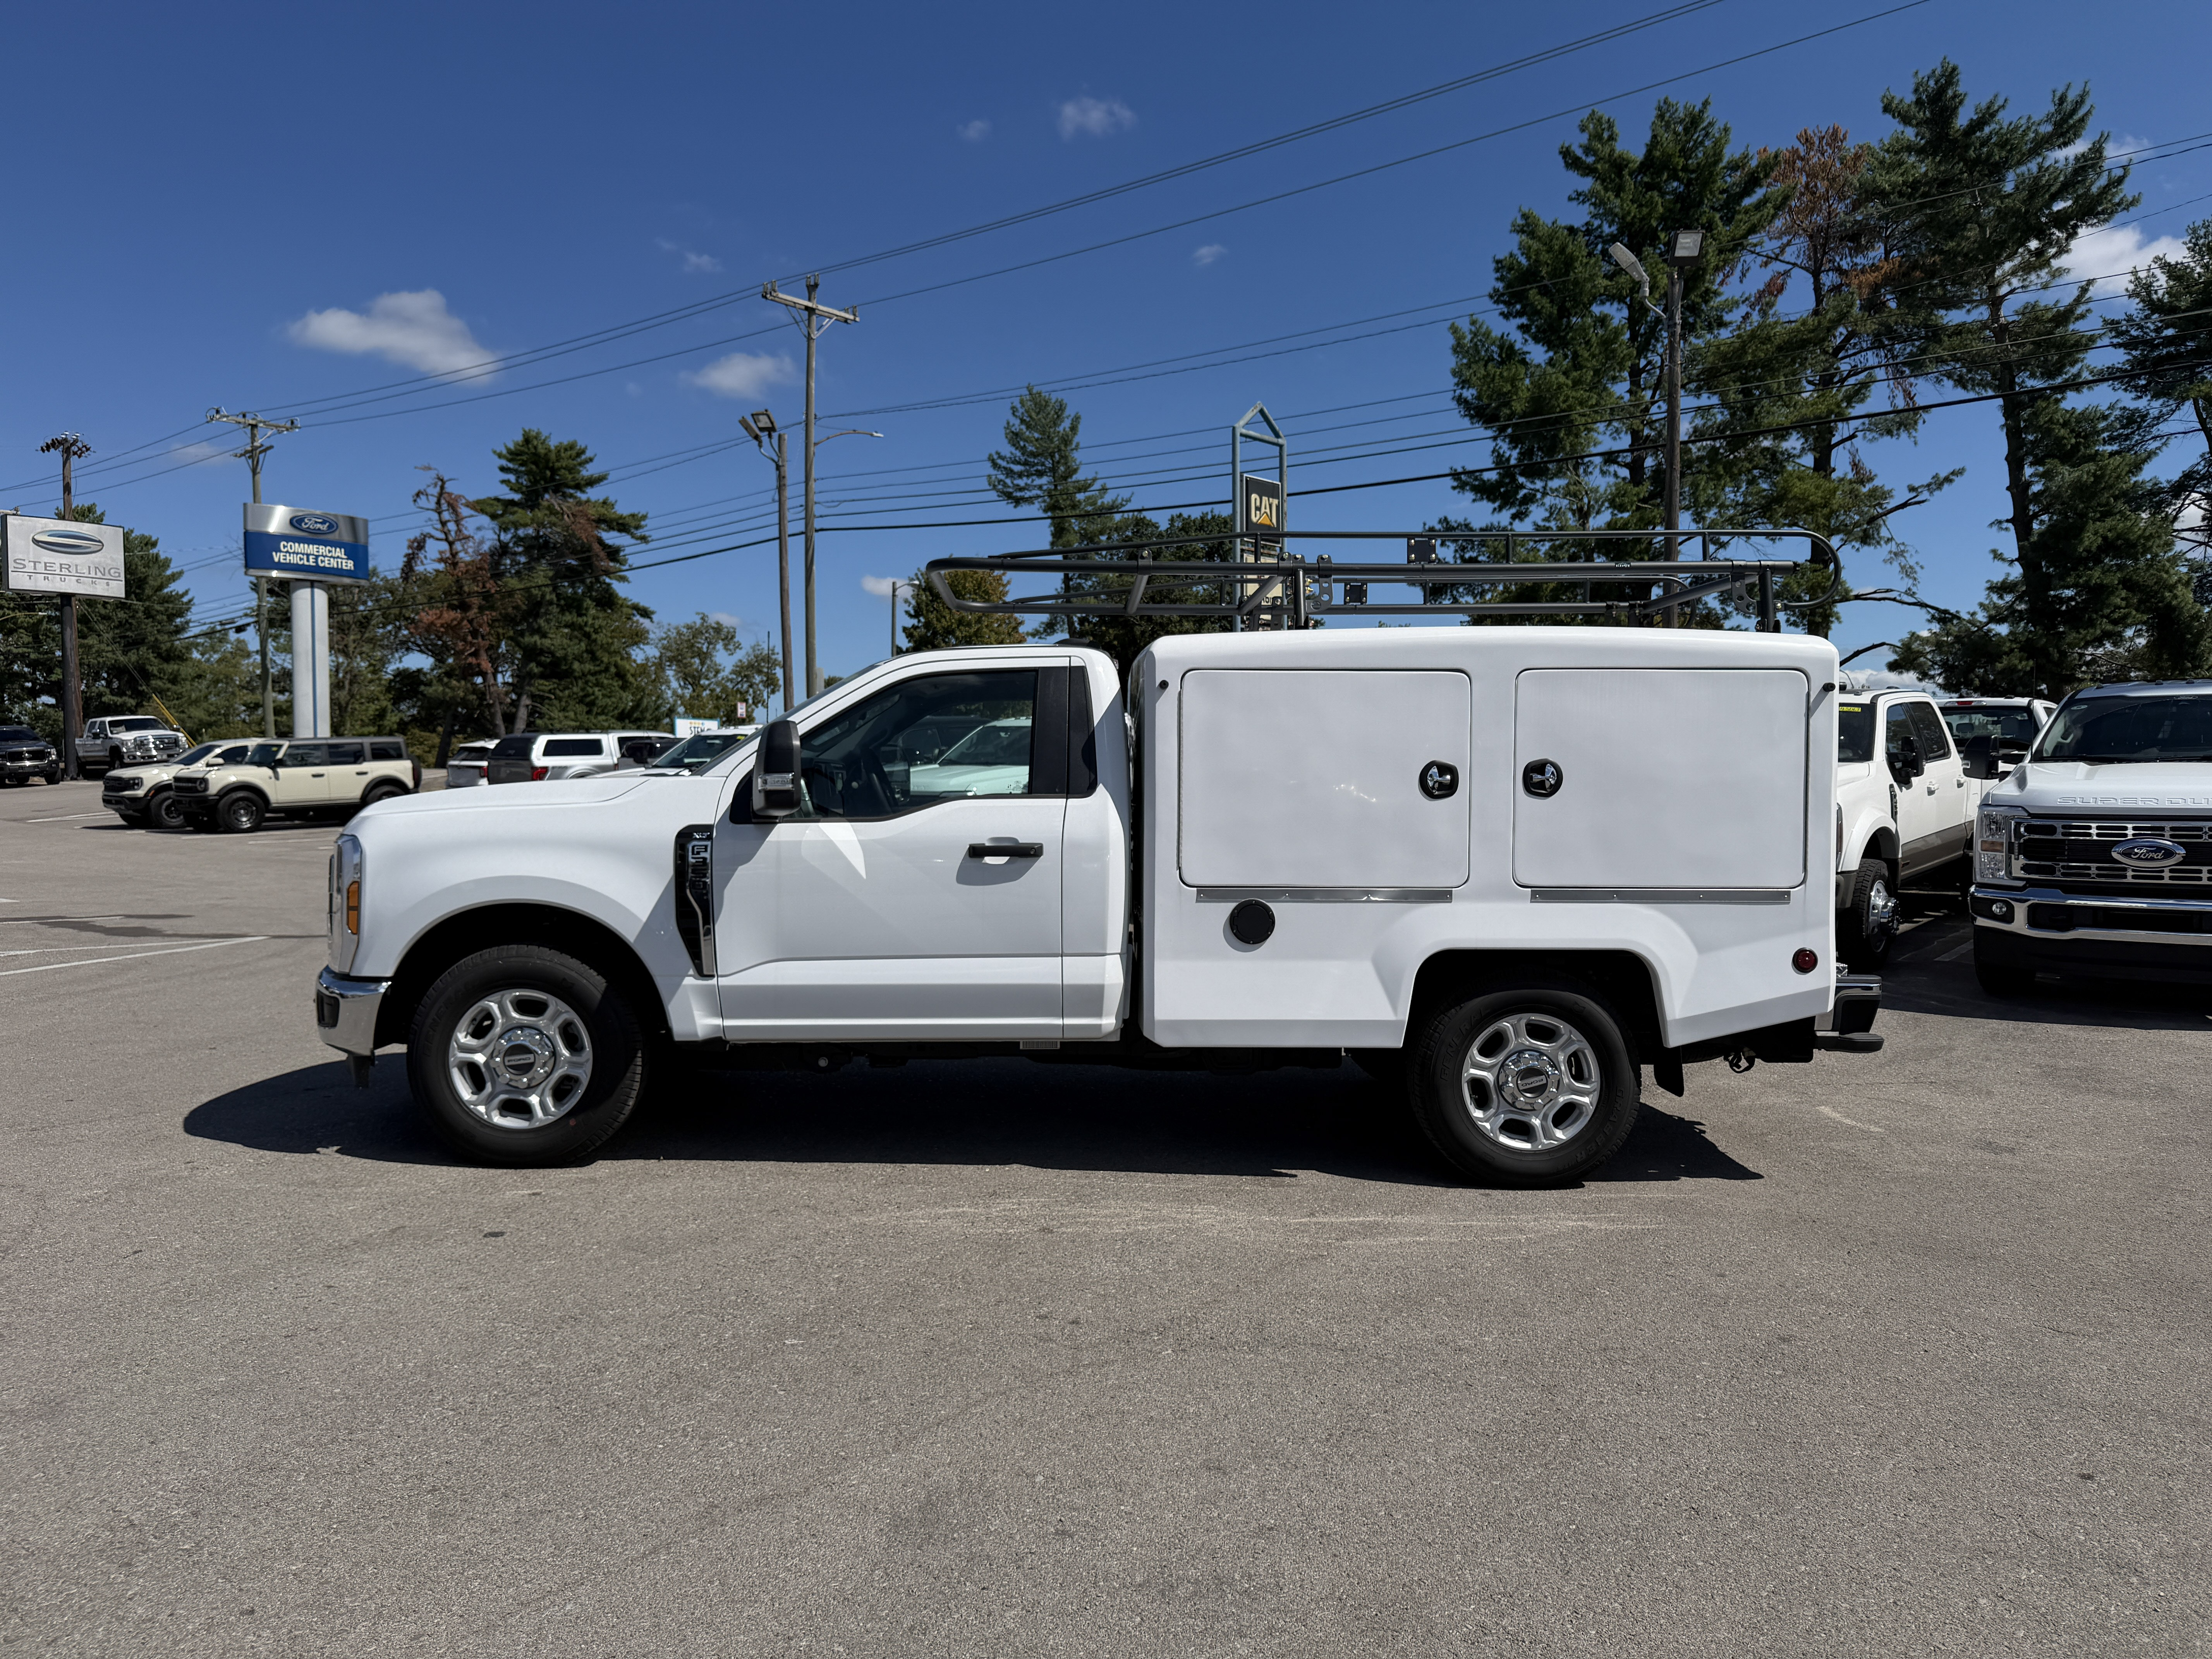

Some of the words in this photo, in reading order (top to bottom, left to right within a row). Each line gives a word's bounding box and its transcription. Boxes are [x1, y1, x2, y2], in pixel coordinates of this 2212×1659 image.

[1251, 494, 1279, 527] CAT
[302, 517, 329, 531] Ford
[280, 541, 348, 558] COMMERCIAL
[272, 551, 316, 566] VEHICLE
[318, 556, 354, 570] CENTER
[13, 558, 121, 578] STERLING
[27, 574, 110, 586] TRUCKS
[2057, 797, 2159, 805] SUPER
[2131, 847, 2165, 859] Ford
[1522, 1079, 1543, 1087] FORD
